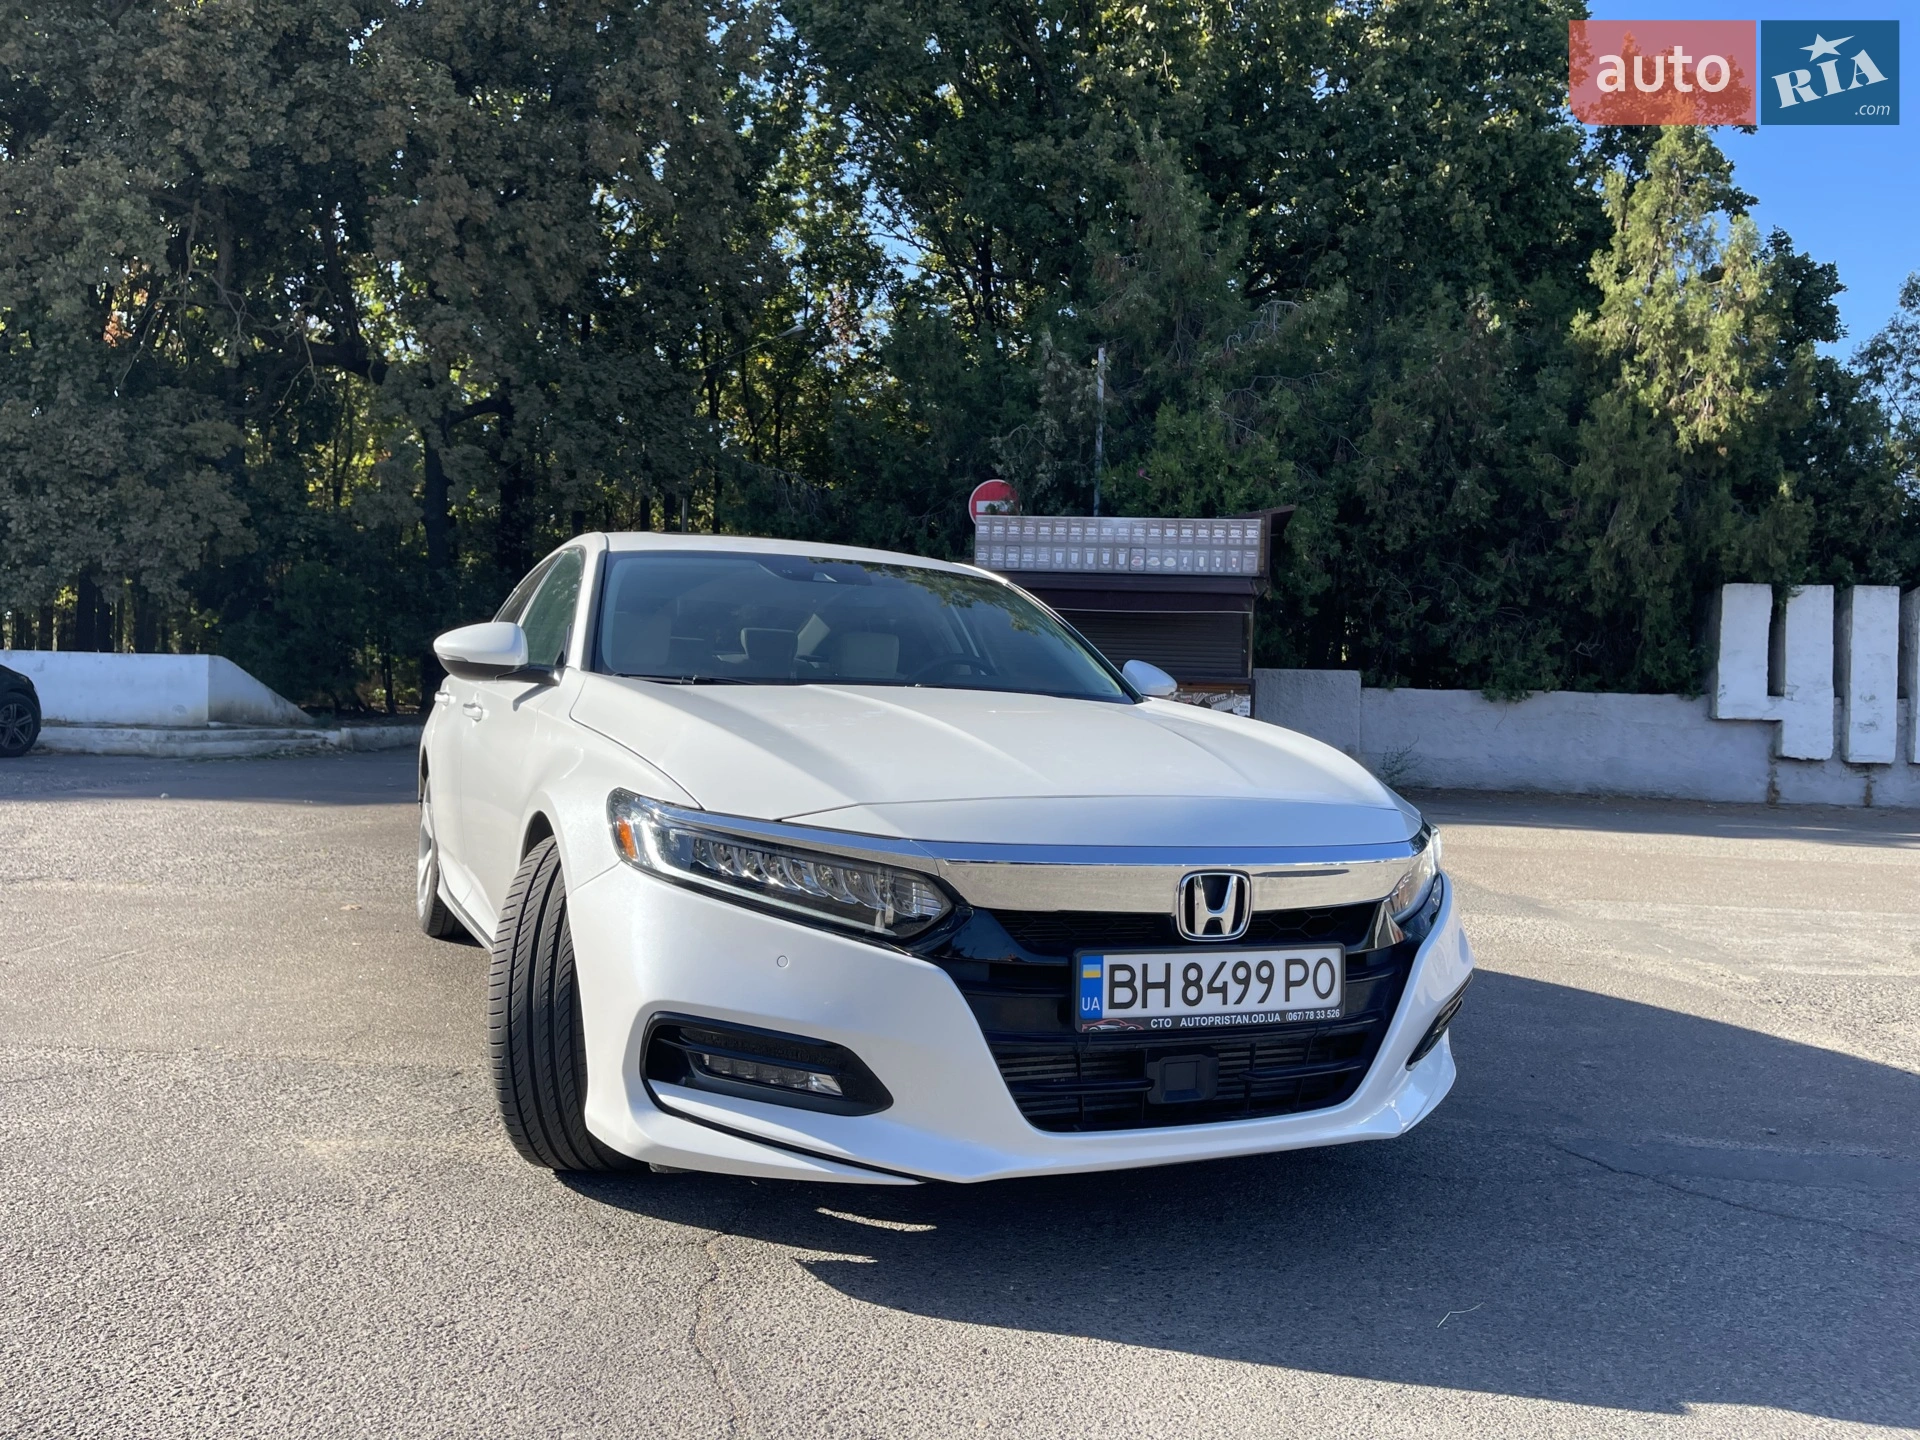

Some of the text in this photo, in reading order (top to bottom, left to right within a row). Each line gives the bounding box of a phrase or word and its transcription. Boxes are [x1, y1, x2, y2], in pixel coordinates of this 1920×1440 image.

[1082, 997, 1100, 1011] UA
[1150, 1009, 1340, 1029] CTO AUTOPRISTAN.OD.UA (067) 78 33 526
